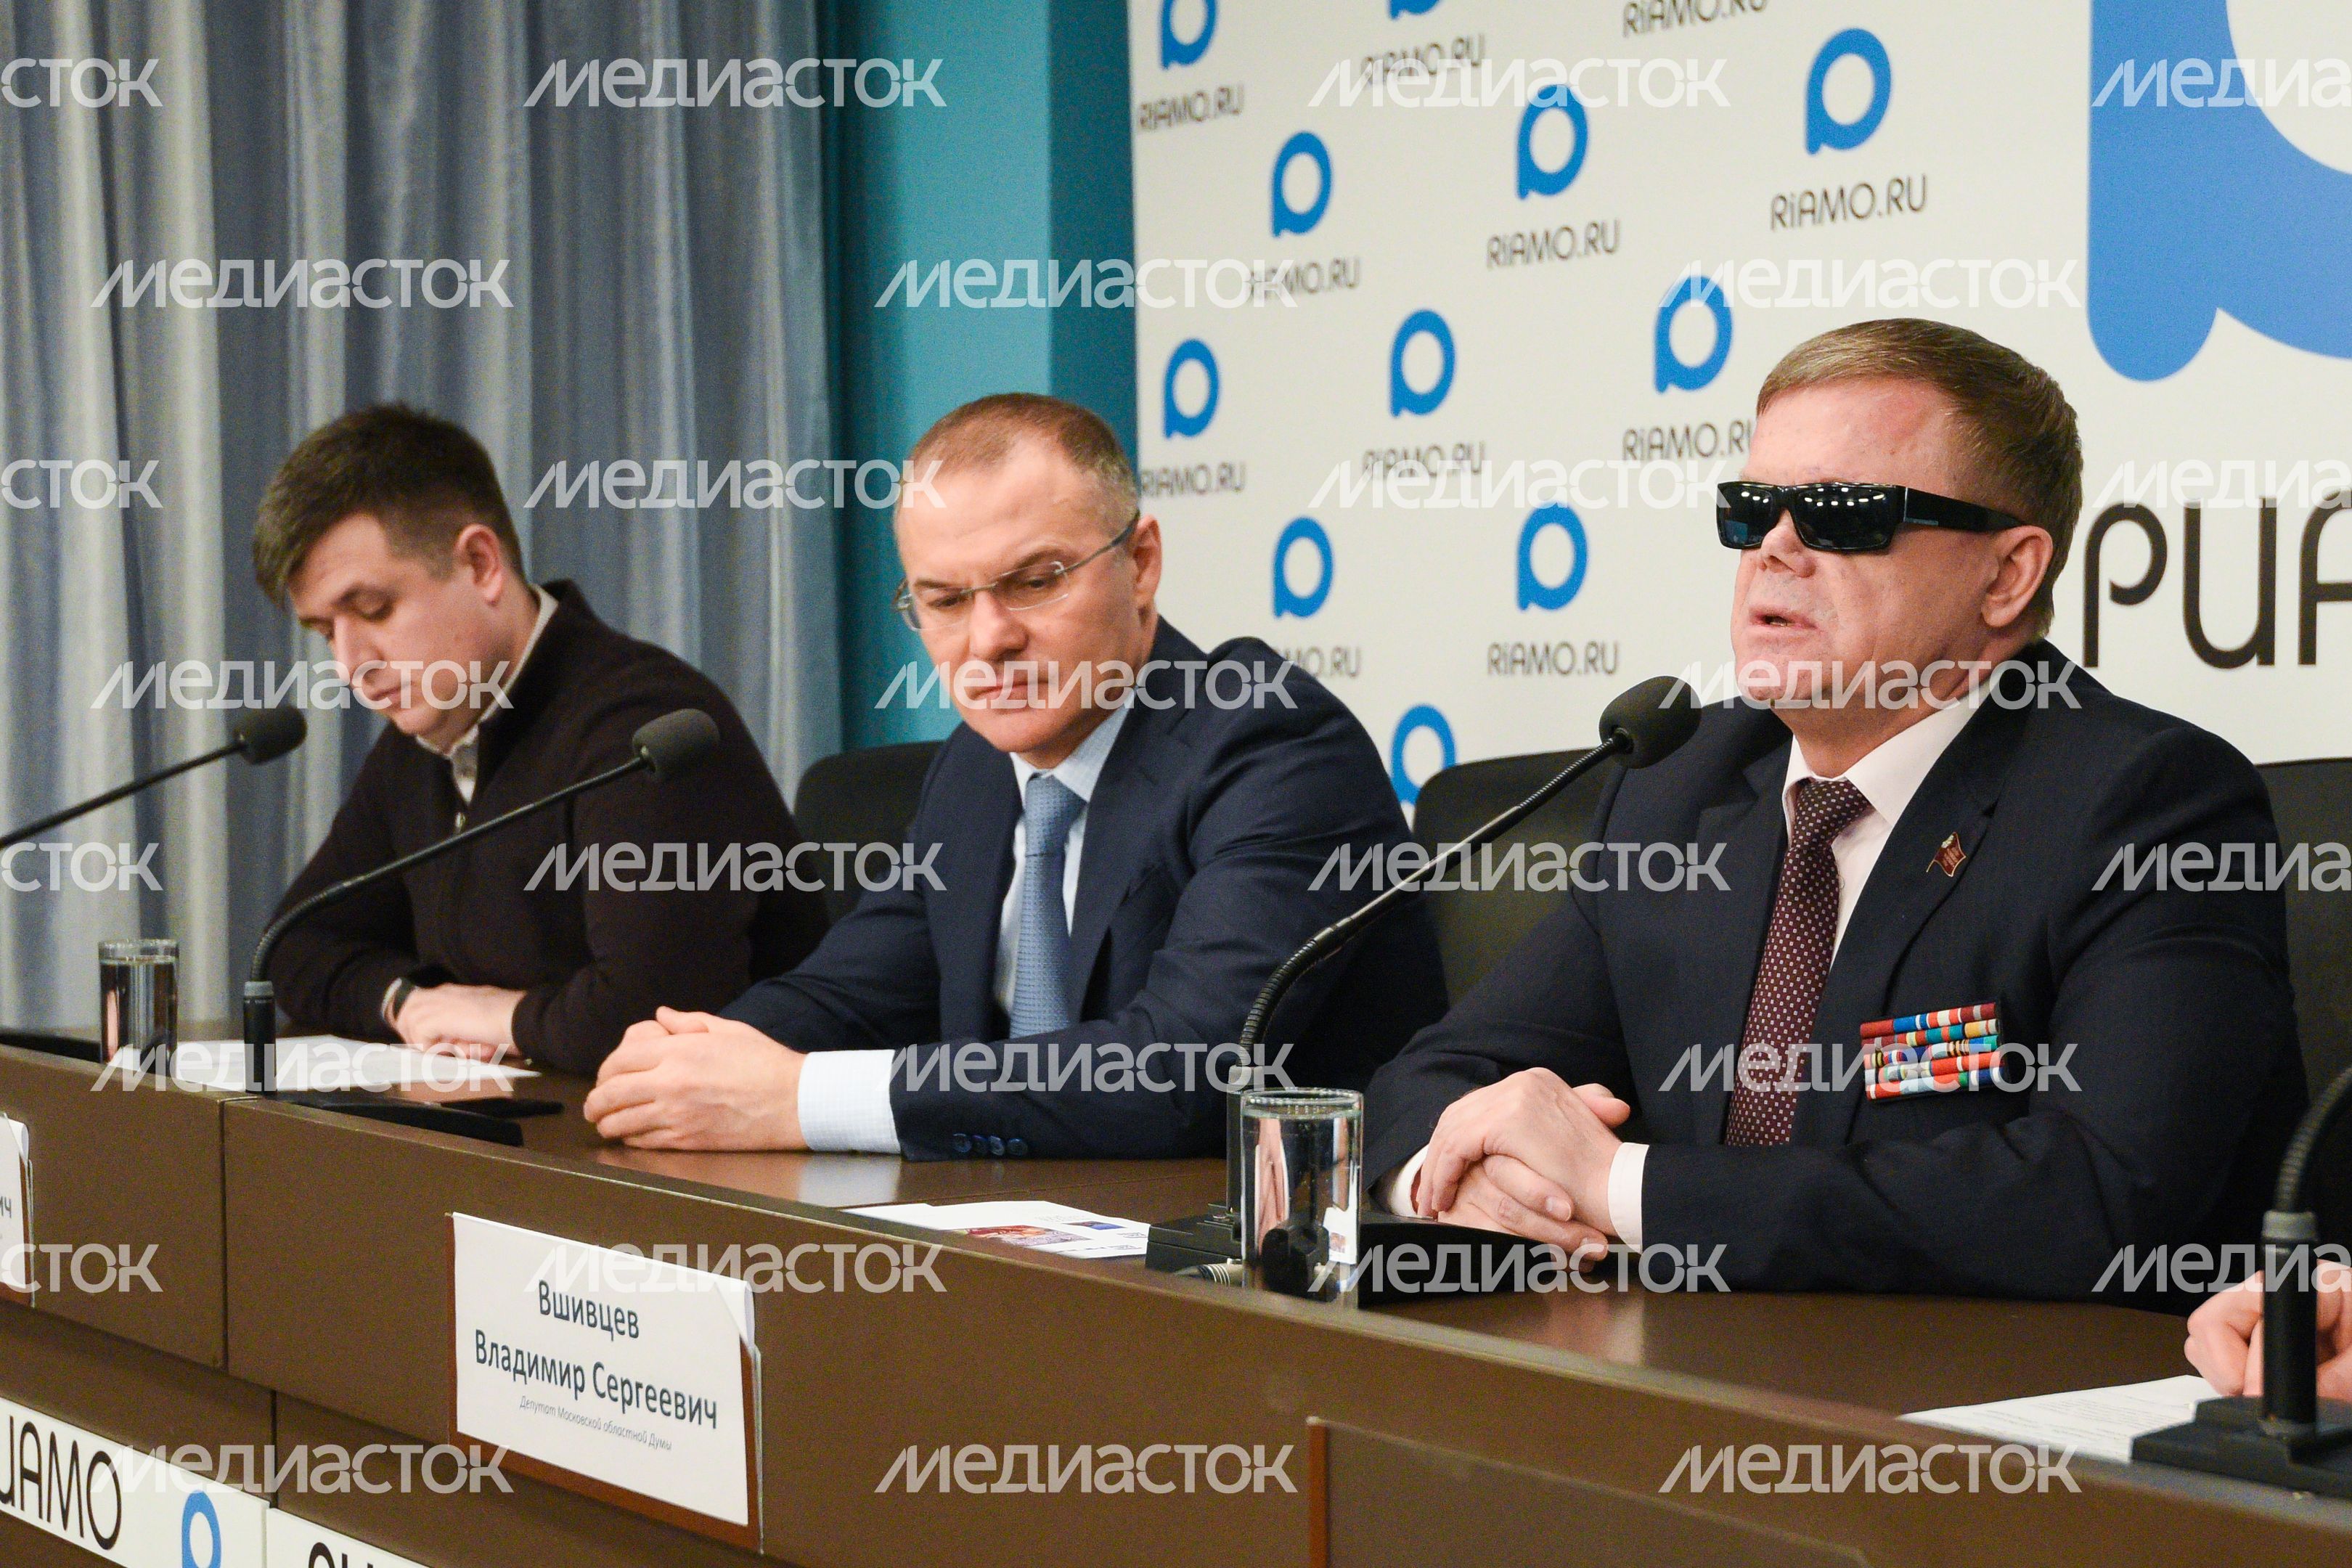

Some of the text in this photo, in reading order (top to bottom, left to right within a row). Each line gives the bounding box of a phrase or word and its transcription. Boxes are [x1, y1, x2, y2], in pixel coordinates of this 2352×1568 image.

[1768, 173, 1928, 231] RiAMO.RU
[539, 1280, 639, 1342] Вшивцев
[475, 1329, 717, 1429] Владимир Сергеевич
[519, 1395, 673, 1451] Депутат Московской областной Думы
